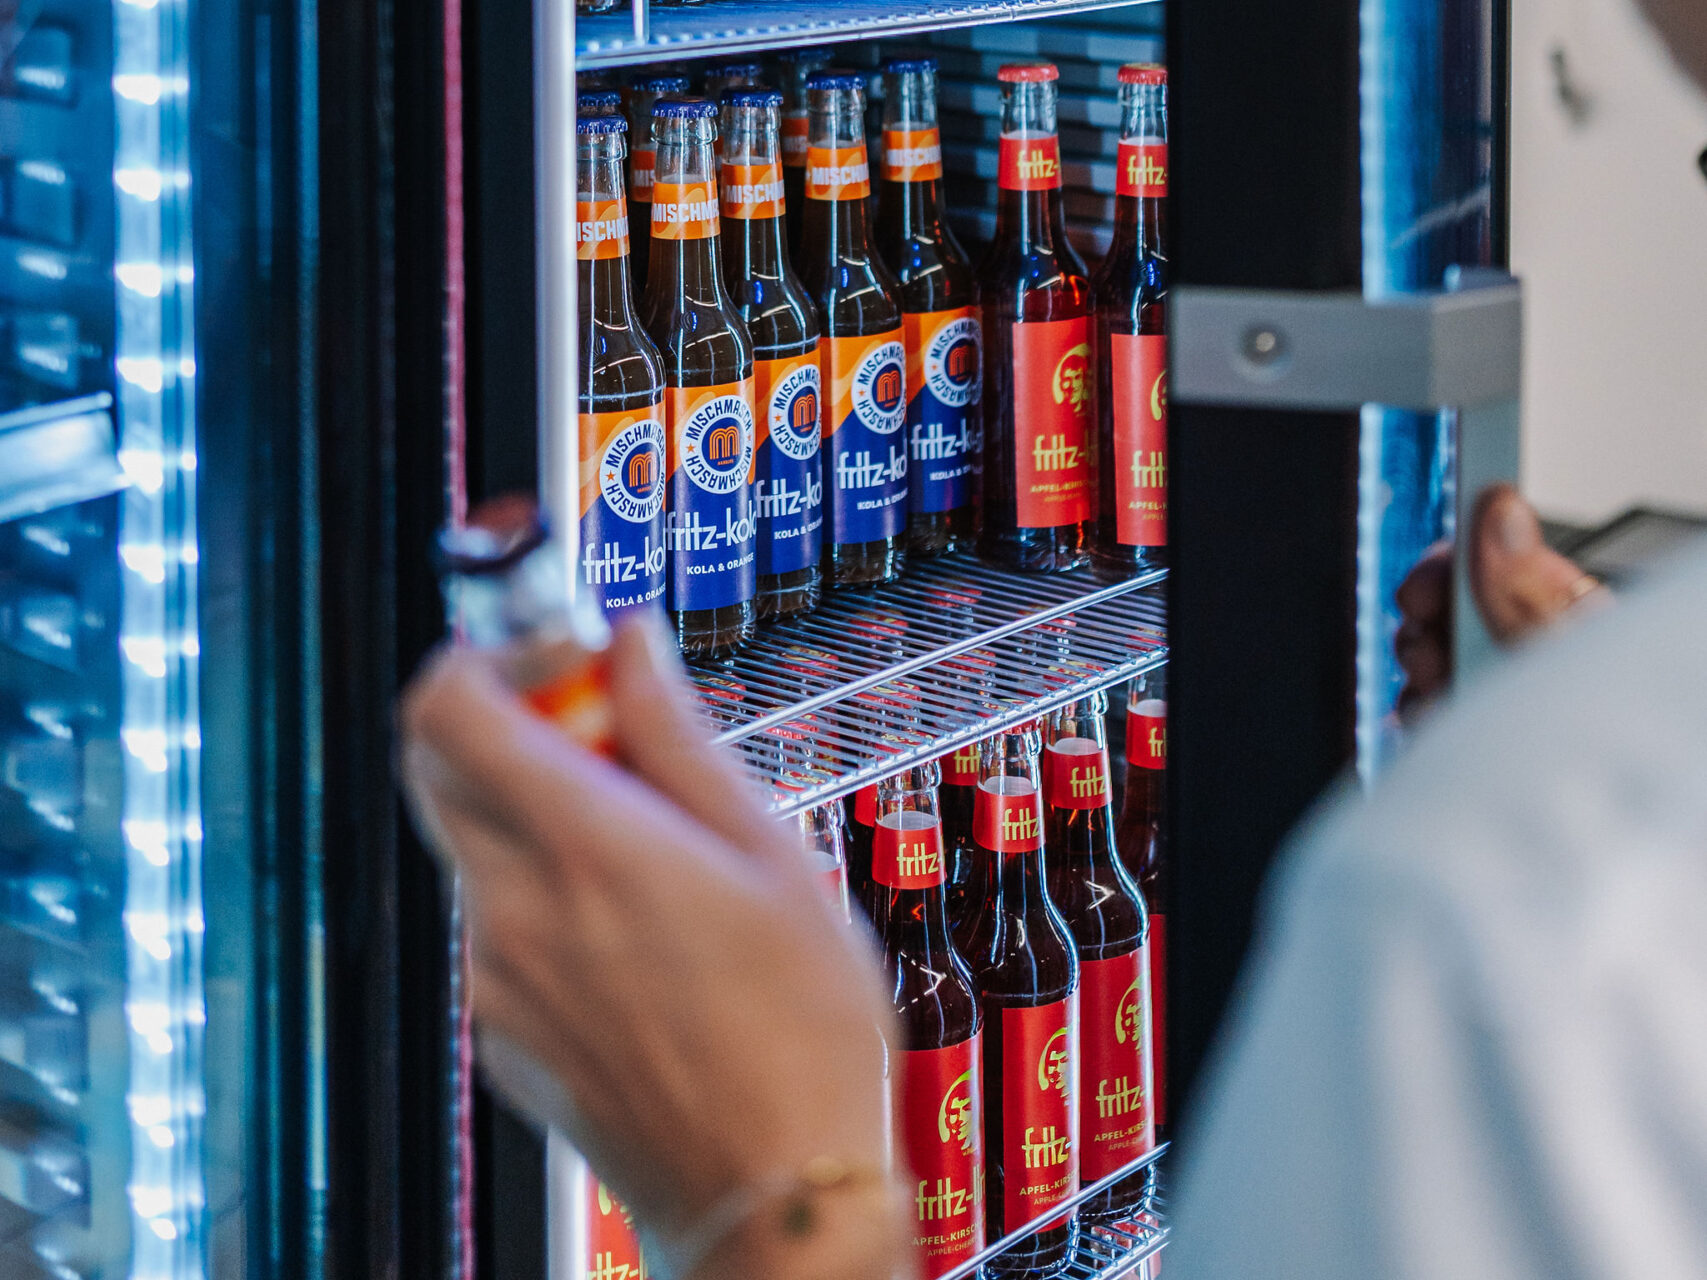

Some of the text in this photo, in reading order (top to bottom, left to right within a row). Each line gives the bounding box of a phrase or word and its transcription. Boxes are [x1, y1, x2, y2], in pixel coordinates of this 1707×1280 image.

[774, 528, 799, 540] KOLA
[686, 564, 715, 575] KOLA
[718, 563, 725, 572] &
[606, 596, 634, 608] KOLA
[637, 593, 643, 603] &
